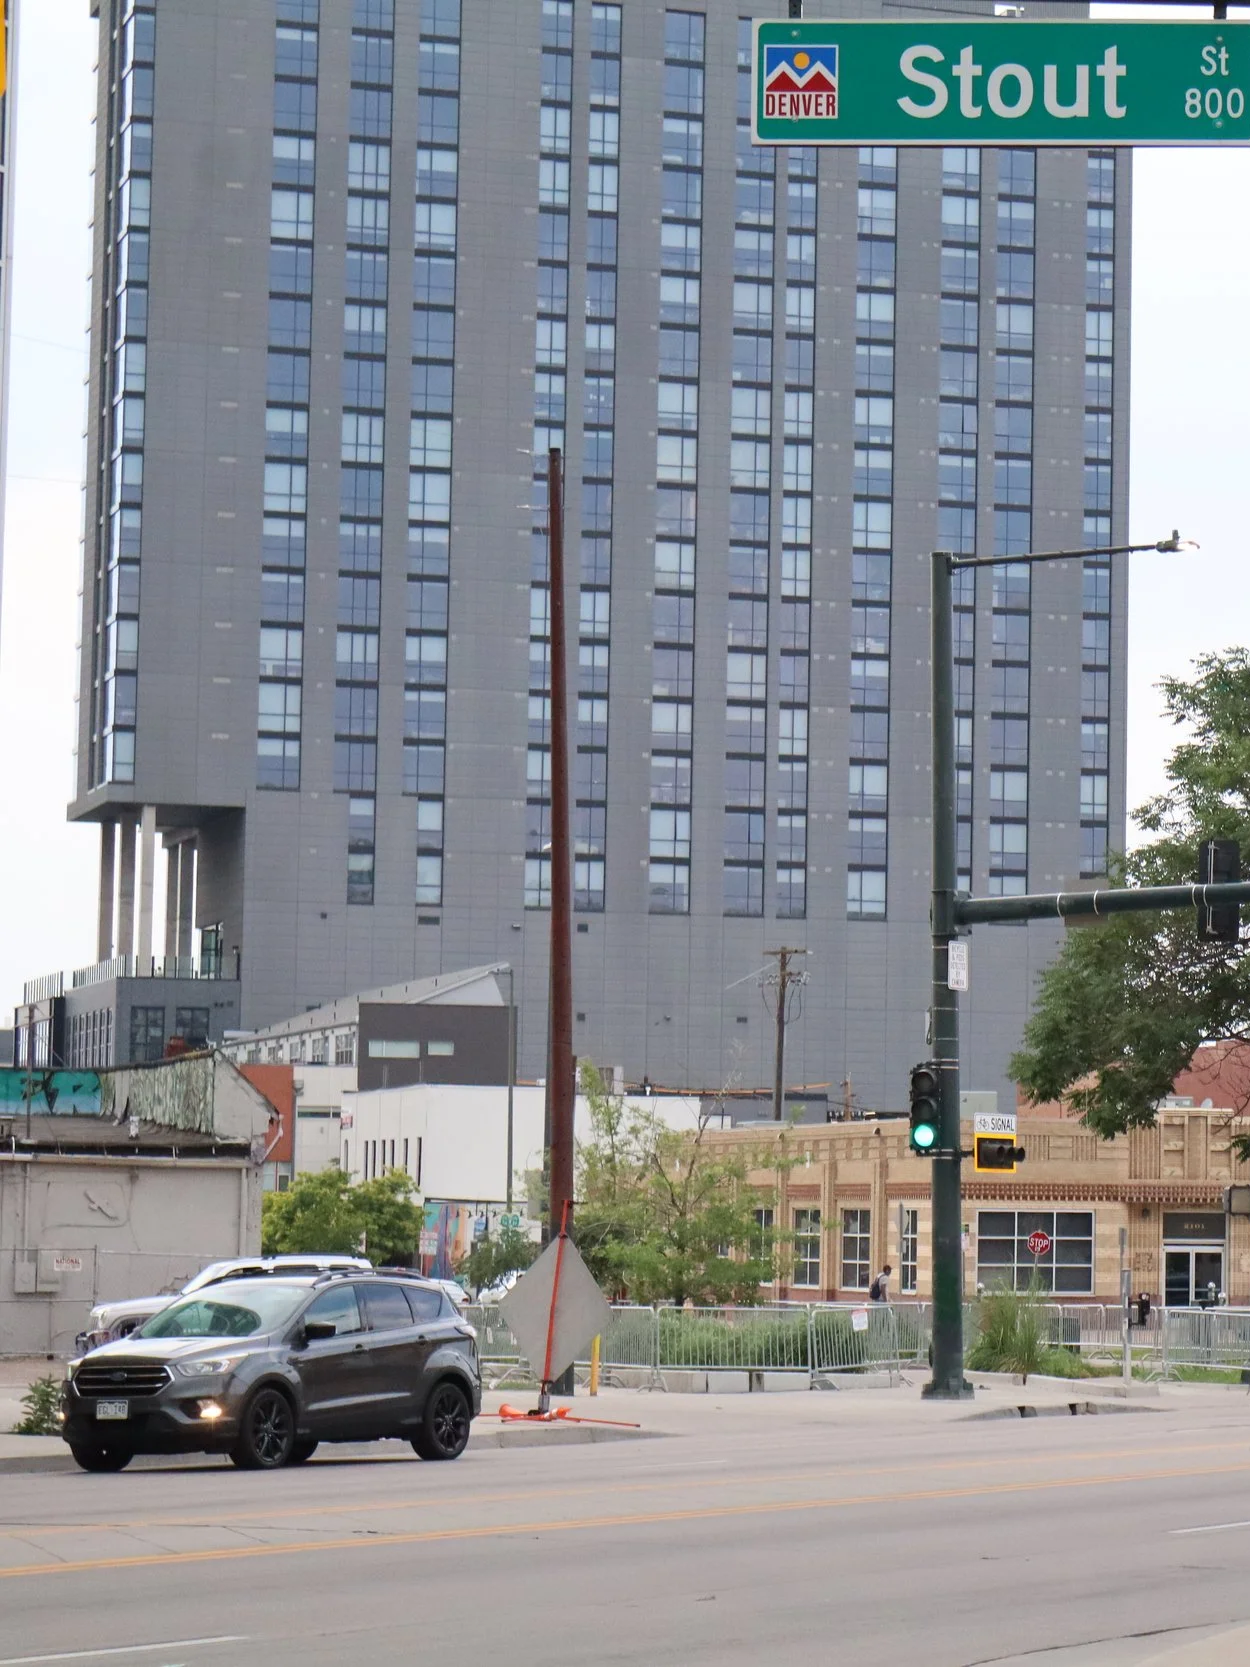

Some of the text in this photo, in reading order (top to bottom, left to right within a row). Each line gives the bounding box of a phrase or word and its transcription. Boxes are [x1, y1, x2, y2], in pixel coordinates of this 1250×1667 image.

[896, 44, 1229, 119] Stout St
[765, 93, 836, 117] DENVER
[1184, 87, 1244, 119] 800
[991, 1117, 1015, 1131] SIGNAL
[1029, 1237, 1049, 1248] STOP
